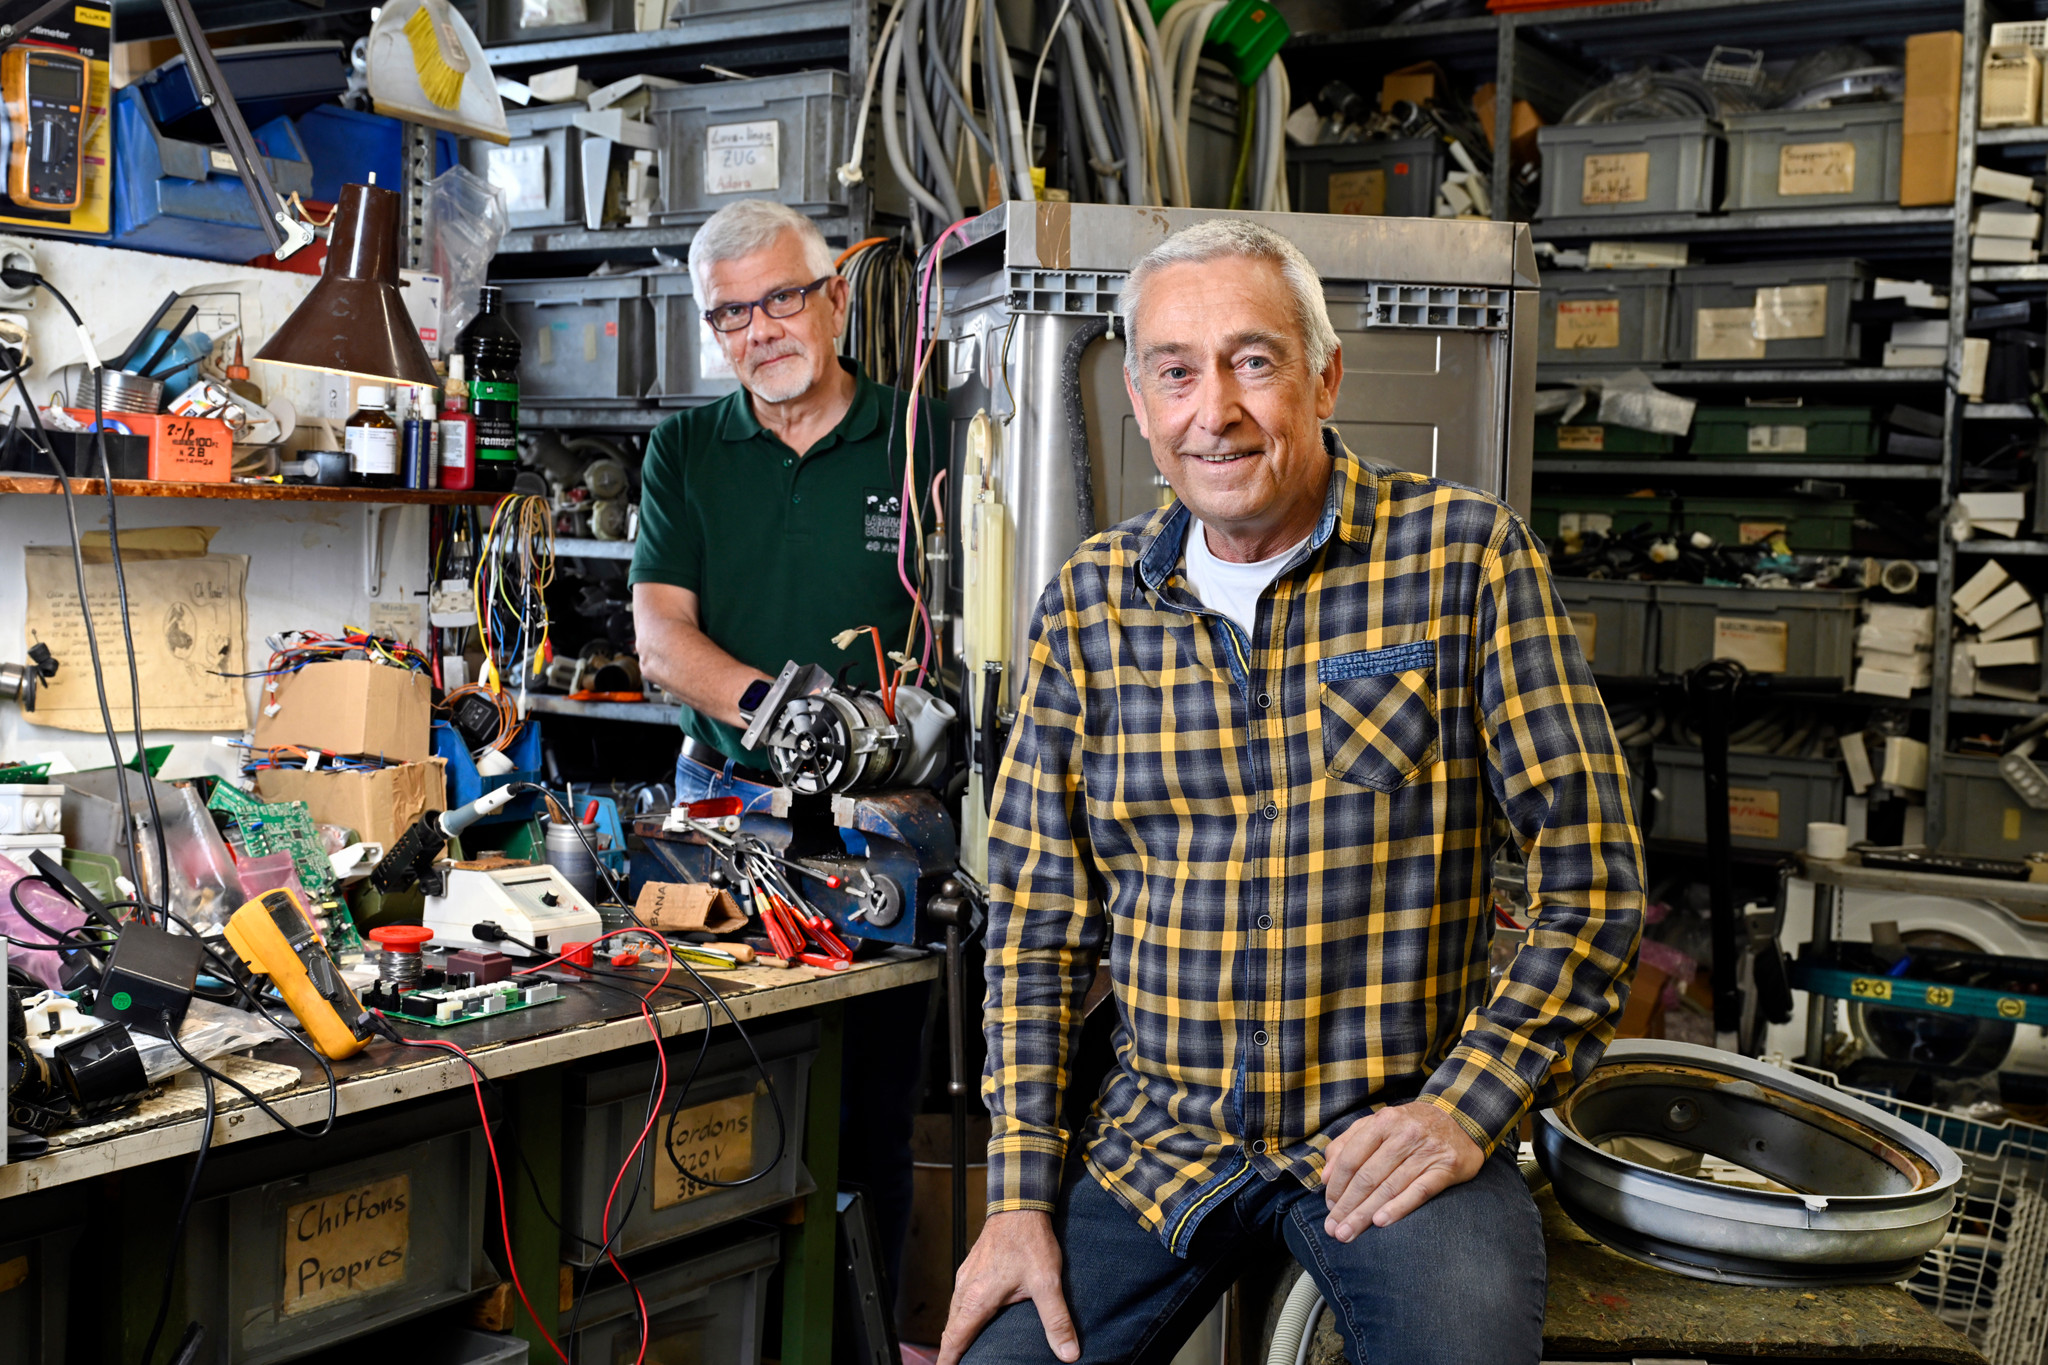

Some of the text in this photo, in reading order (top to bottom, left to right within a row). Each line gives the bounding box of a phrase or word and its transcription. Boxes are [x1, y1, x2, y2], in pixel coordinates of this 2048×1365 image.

[79, 12, 107, 21] FLUKE
[723, 149, 756, 168] ZUG
[297, 1190, 406, 1242] Chiffons
[298, 1246, 403, 1299] Propres
